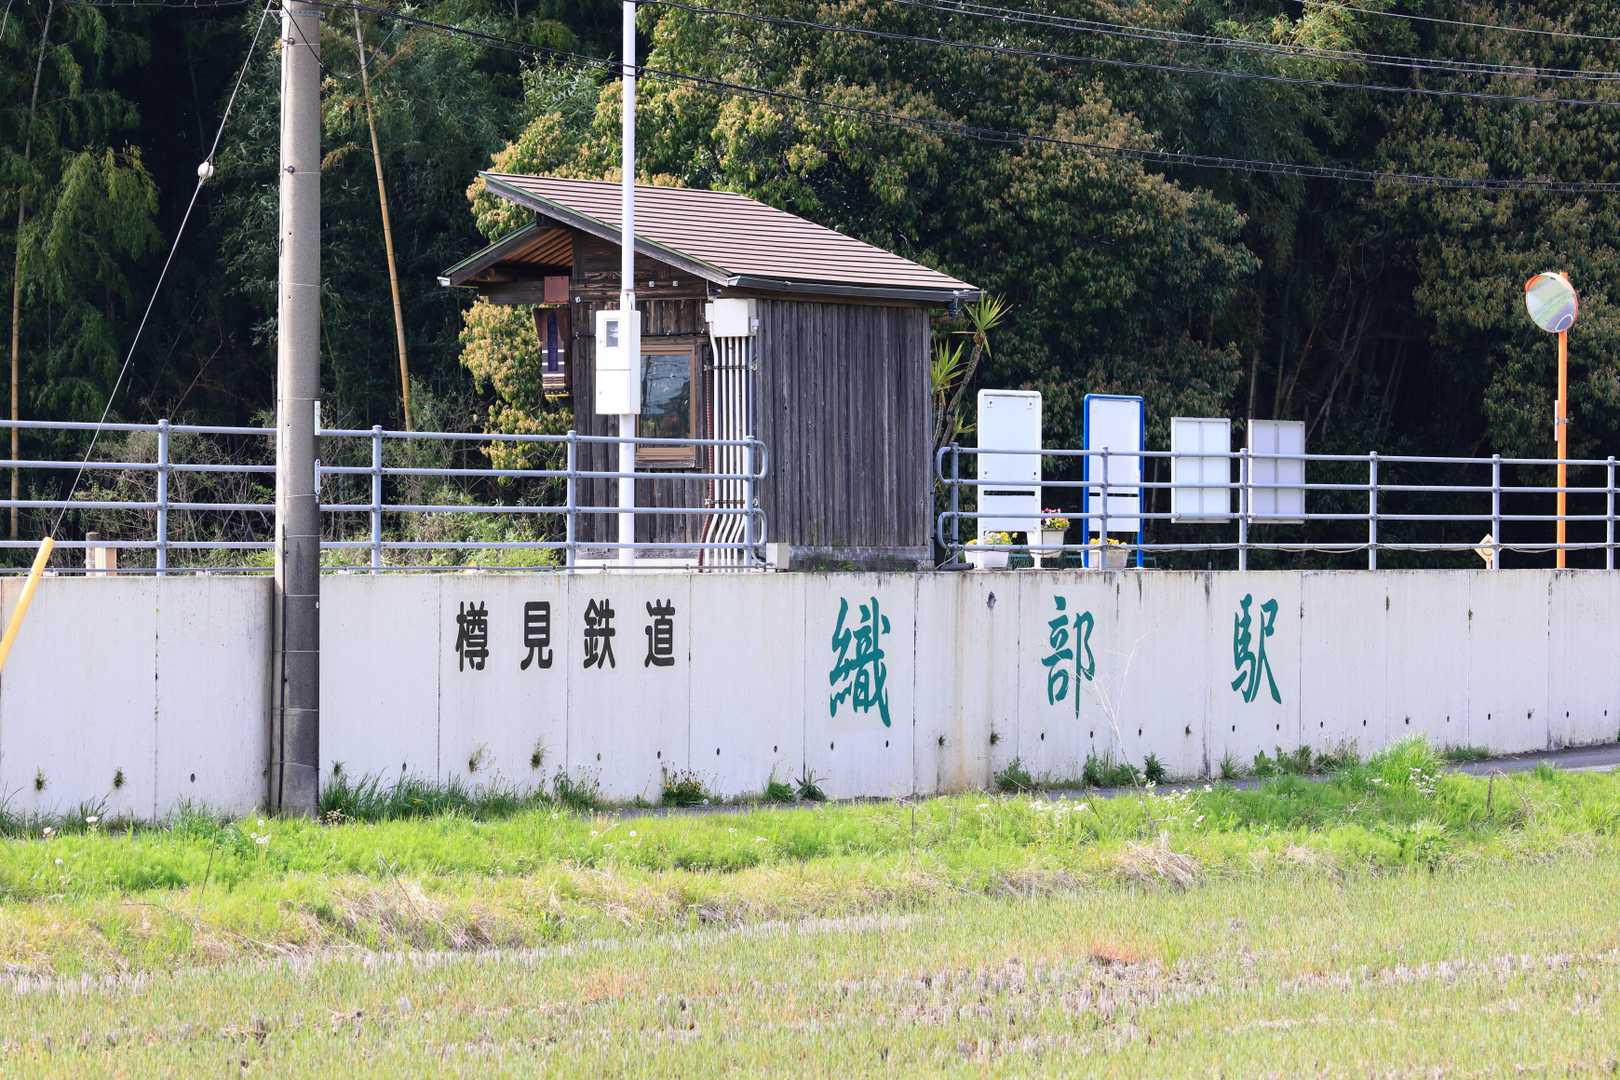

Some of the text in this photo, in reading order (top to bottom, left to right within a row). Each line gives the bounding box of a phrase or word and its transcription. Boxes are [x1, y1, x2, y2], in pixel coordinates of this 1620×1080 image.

[455, 598, 676, 673] 樽見鉄道
[828, 595, 1282, 728] 織部駅
